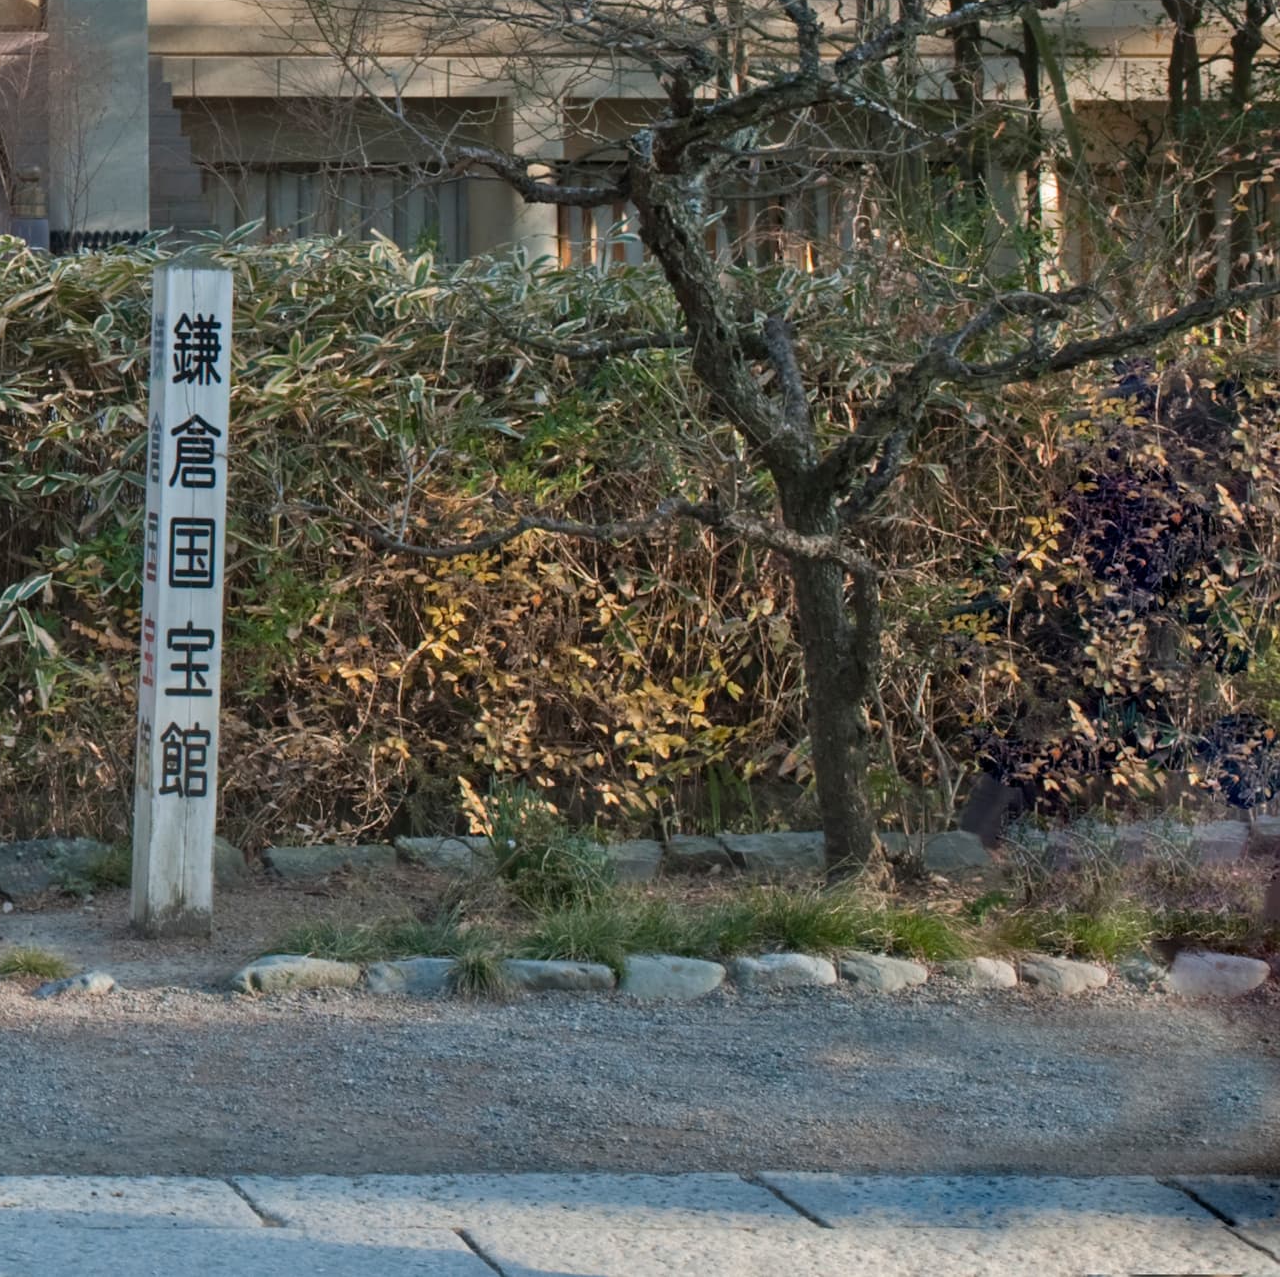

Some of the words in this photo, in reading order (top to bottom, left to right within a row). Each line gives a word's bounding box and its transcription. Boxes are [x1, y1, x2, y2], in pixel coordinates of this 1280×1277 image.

[158, 313, 222, 799] 鎌倉国宝館
